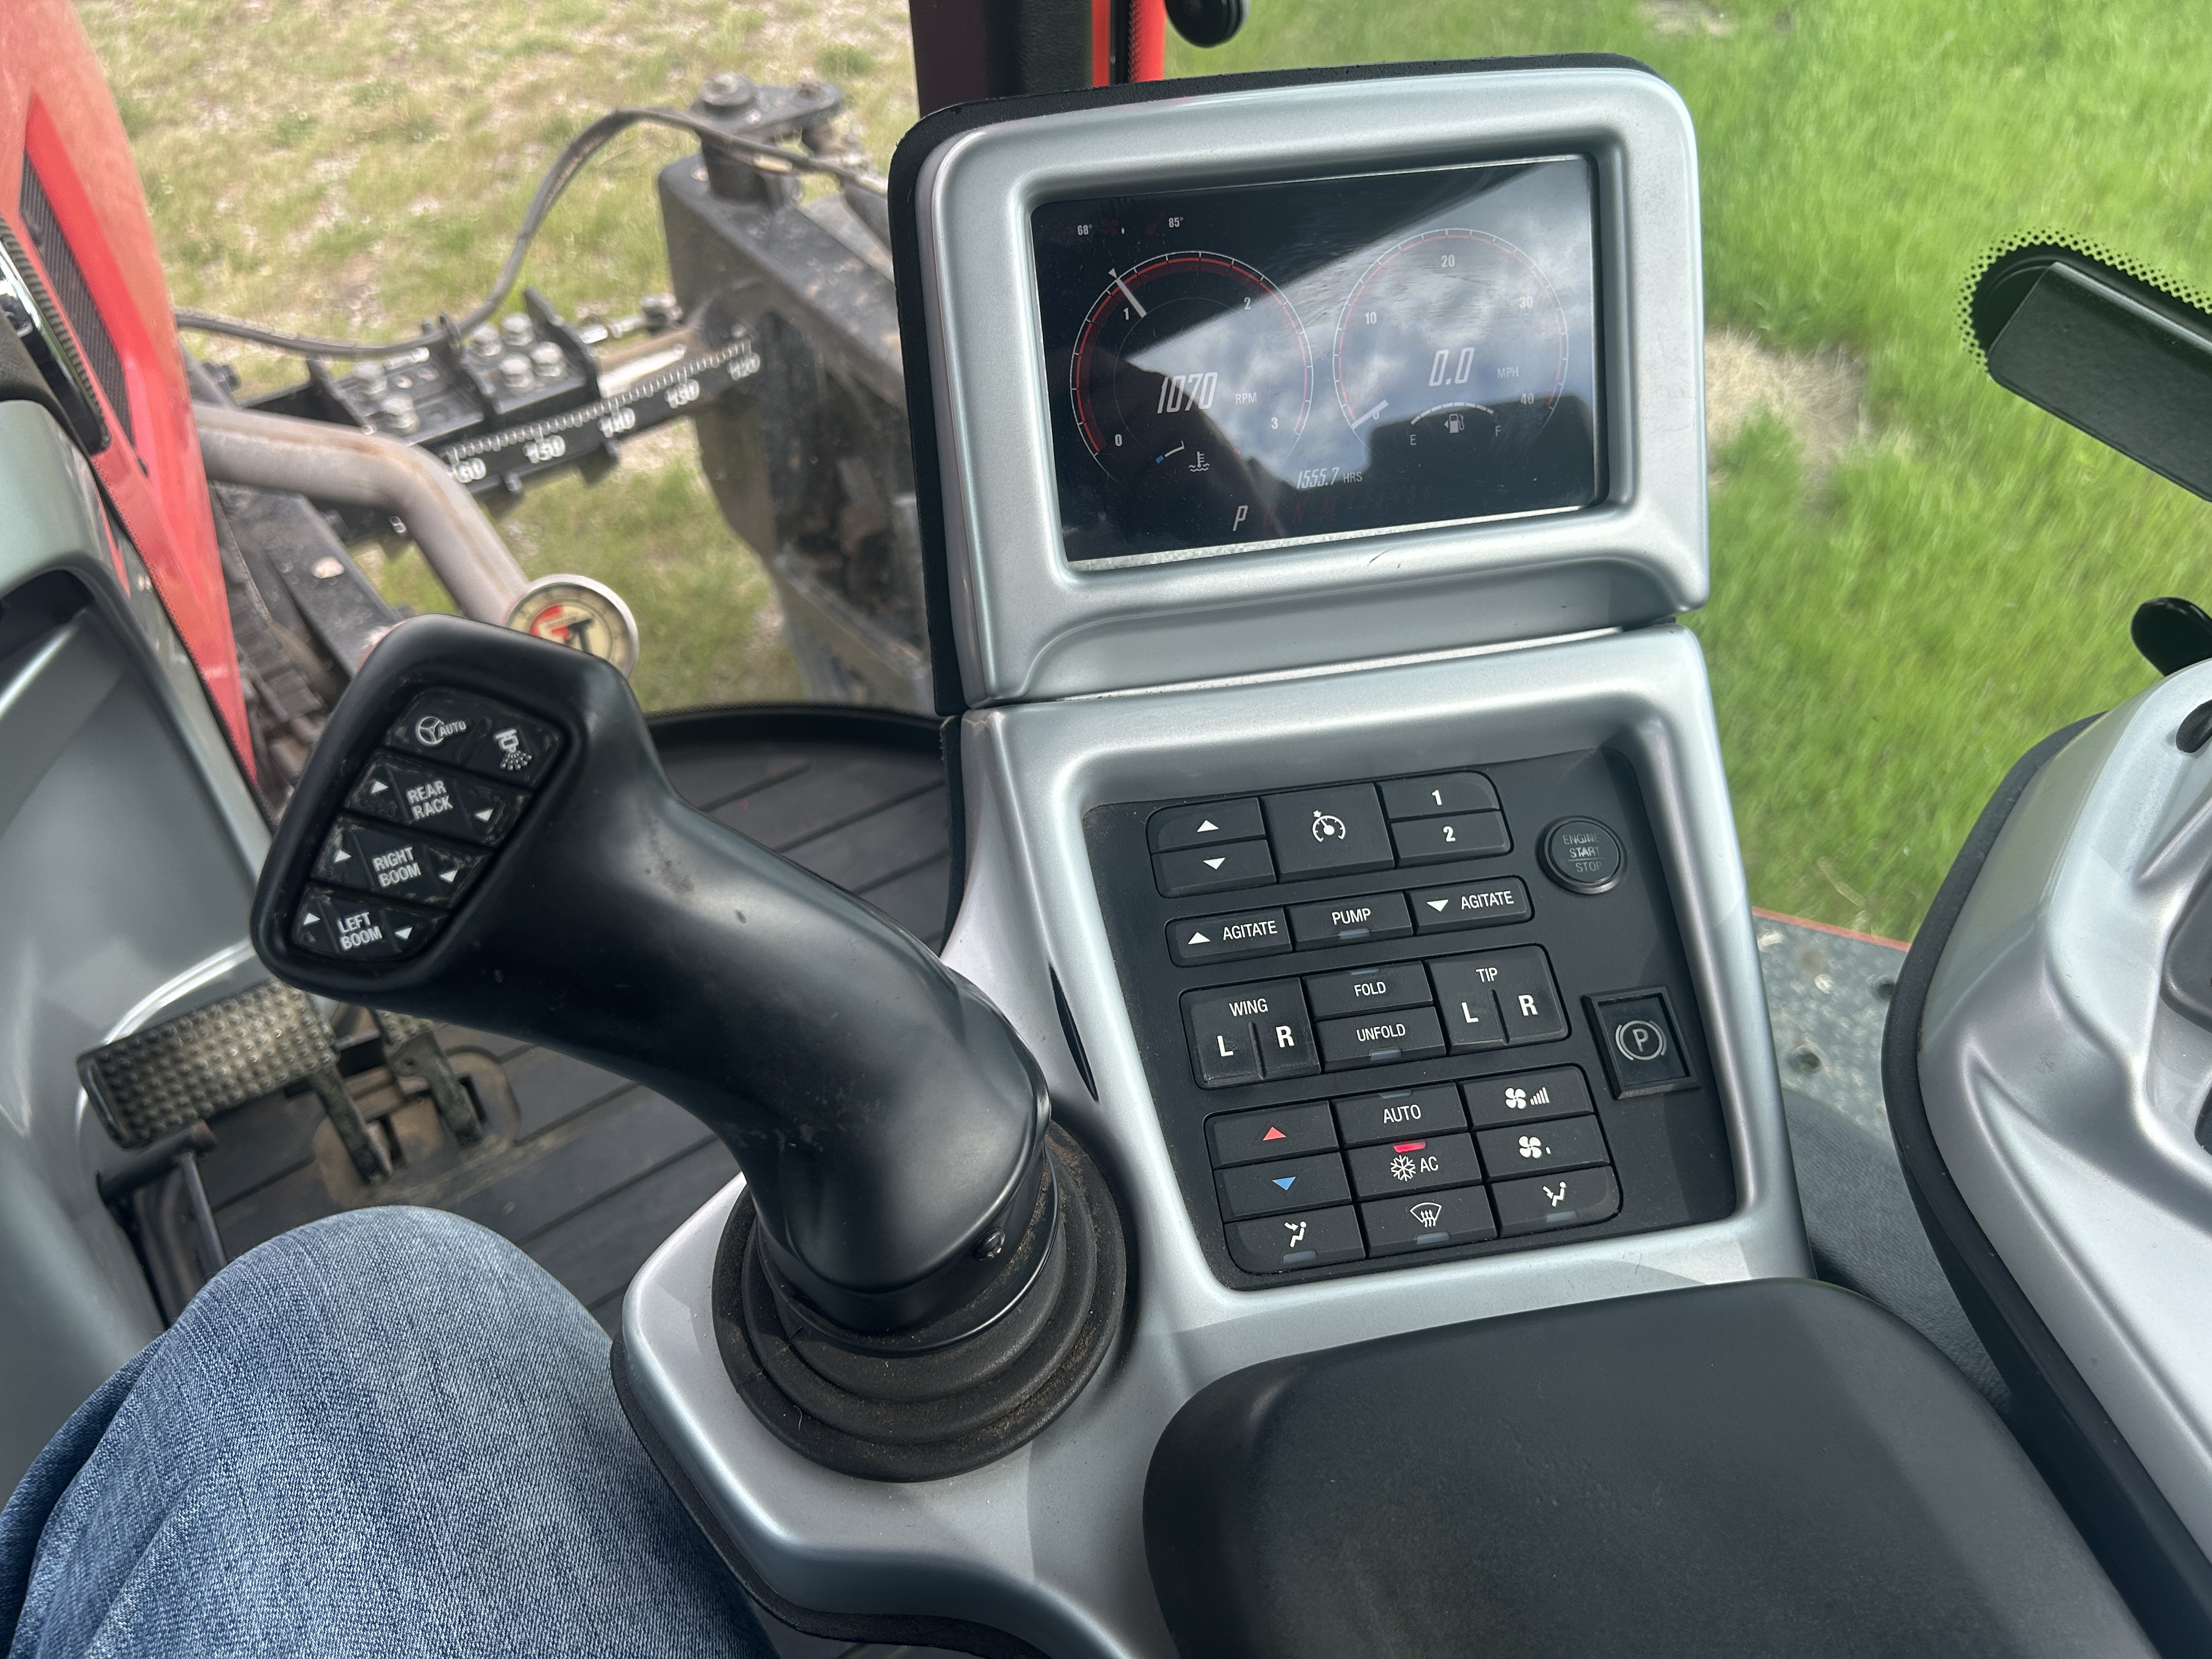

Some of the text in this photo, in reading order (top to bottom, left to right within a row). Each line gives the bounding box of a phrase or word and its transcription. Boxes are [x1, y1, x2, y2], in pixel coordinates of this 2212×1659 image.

[1441, 255, 1455, 268] 20
[1244, 297, 1251, 311] 2
[1519, 296, 1534, 309] 30
[1123, 308, 1130, 321] 1
[1364, 312, 1378, 325] 10
[1429, 347, 1475, 387] 0.0
[1497, 366, 1519, 380] MPH
[1158, 372, 1257, 414] 1070 RPM
[1520, 393, 1534, 405] 40
[1271, 417, 1279, 430] 3
[1495, 425, 1502, 437] F
[1114, 434, 1123, 447] 0
[1409, 434, 1417, 446] E
[1296, 467, 1363, 489] 1555.7 HRS
[1232, 505, 1249, 532] P
[438, 720, 467, 738] AUTO
[408, 780, 447, 804] REAR
[1431, 789, 1442, 806] 1
[412, 795, 454, 821] RACK
[1443, 826, 1456, 842] 2
[1562, 833, 1600, 845] ENGINE
[373, 847, 415, 871] RIGHT
[1568, 846, 1601, 859] START
[379, 862, 422, 888] BOOM
[1575, 860, 1602, 873] STOP
[1462, 891, 1514, 910] AGITATE
[337, 912, 371, 934] LEFT
[1332, 909, 1372, 926] PUMP
[340, 926, 383, 951] BOOM
[1223, 921, 1278, 941] AGITATE
[1476, 968, 1498, 983] TIP
[1354, 982, 1386, 997] FOLD
[1229, 998, 1268, 1017] WING
[1462, 995, 1538, 1023] L R
[1217, 1026, 1295, 1057] L R
[1356, 1024, 1406, 1042] UNFOLD
[1384, 1104, 1421, 1124] AUTO
[1421, 1156, 1439, 1173] AC
